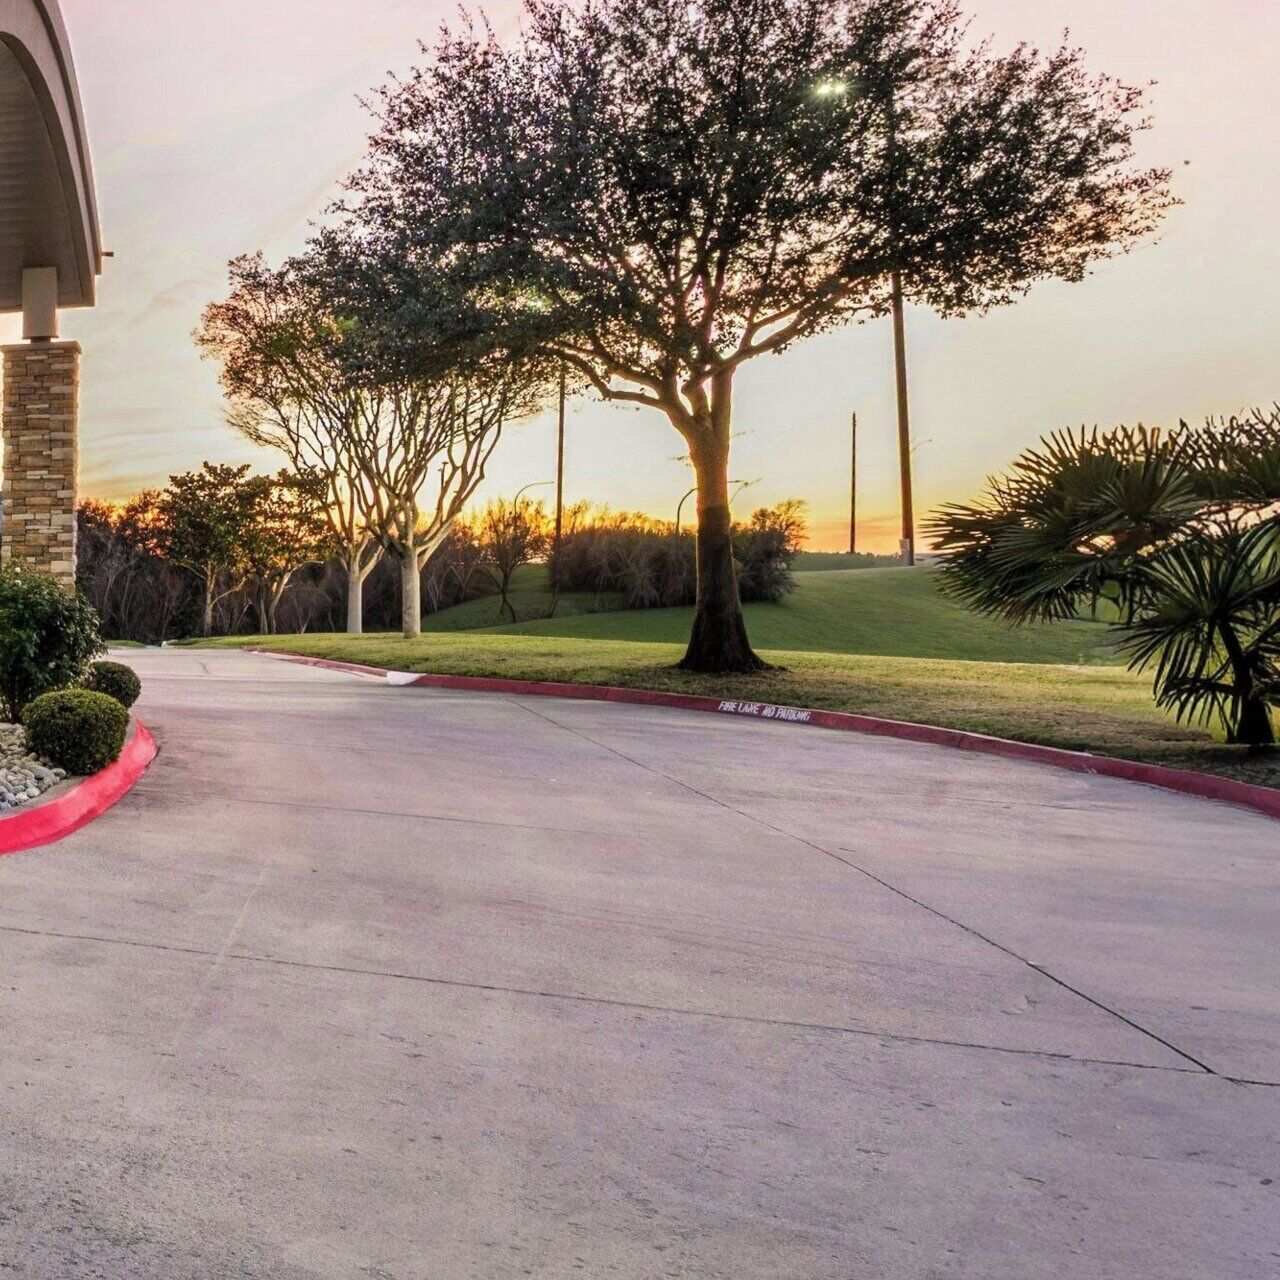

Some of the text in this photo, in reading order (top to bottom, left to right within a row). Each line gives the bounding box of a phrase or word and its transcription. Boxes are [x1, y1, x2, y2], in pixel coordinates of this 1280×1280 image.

[718, 700, 812, 721] FIRE LANE NO PARKING
